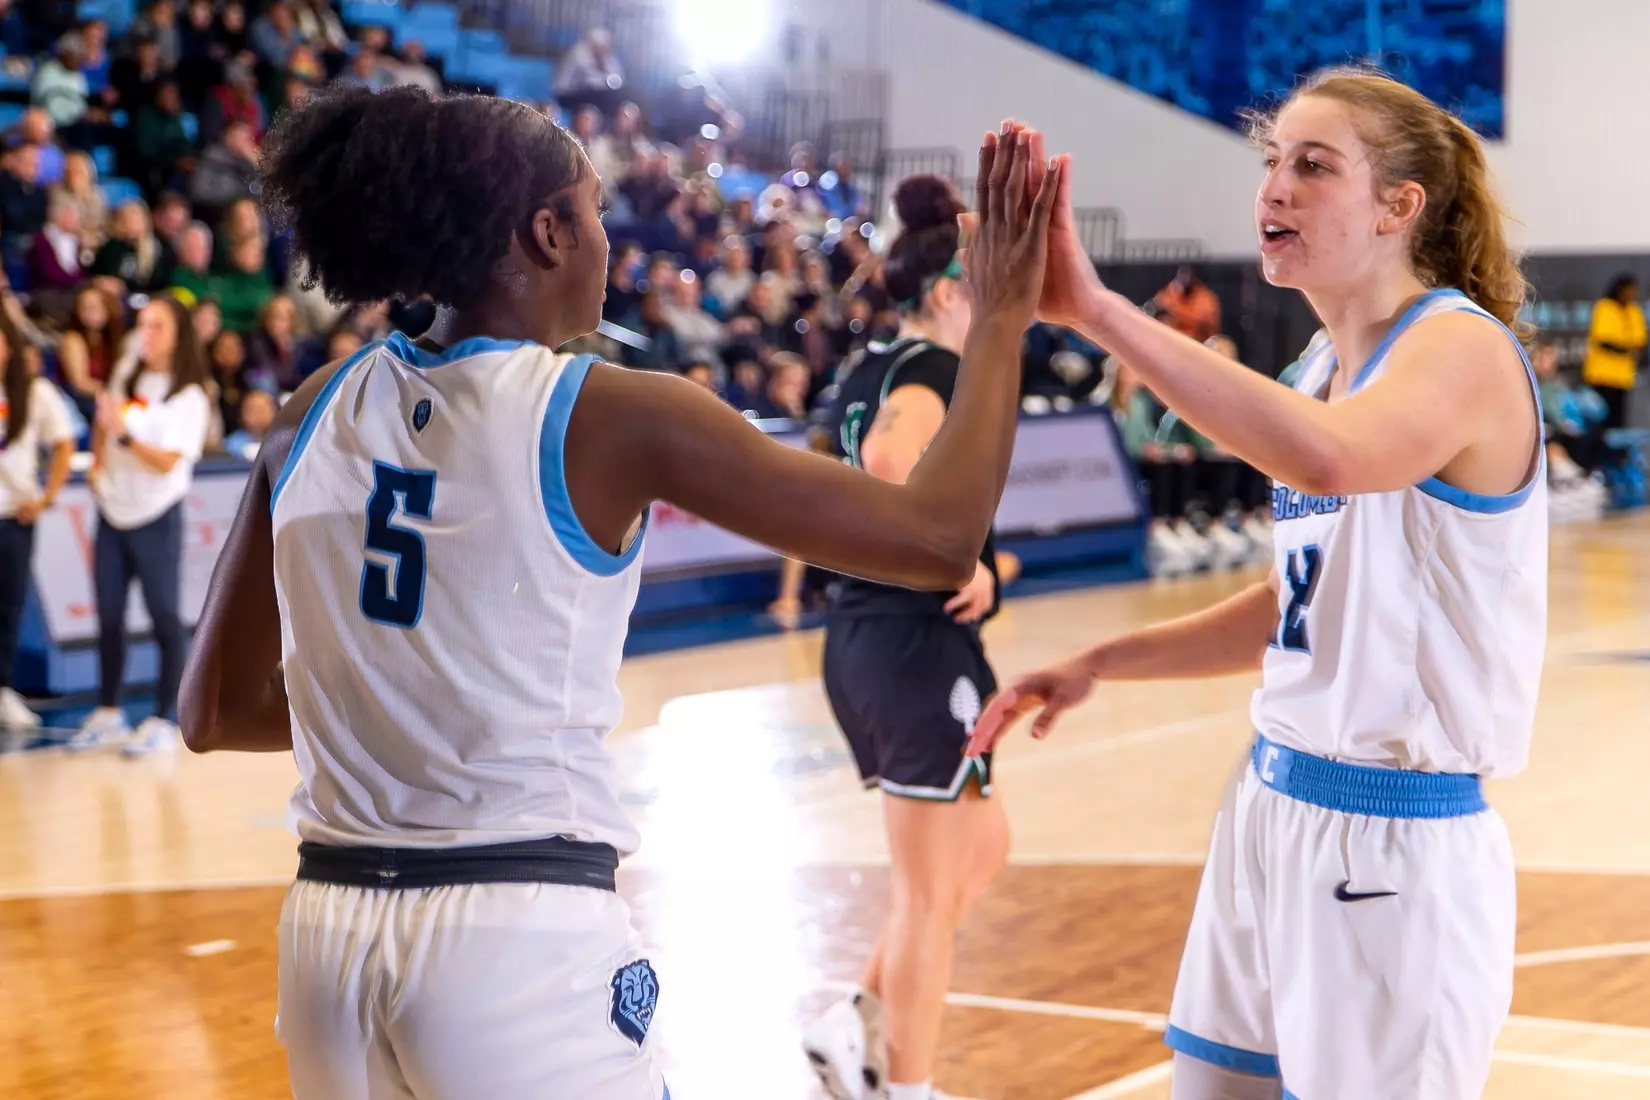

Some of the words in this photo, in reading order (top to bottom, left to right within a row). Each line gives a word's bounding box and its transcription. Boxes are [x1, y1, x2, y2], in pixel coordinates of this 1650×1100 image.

[359, 459, 437, 630] 5
[1268, 544, 1324, 656] 2
[1260, 745, 1279, 784] C
